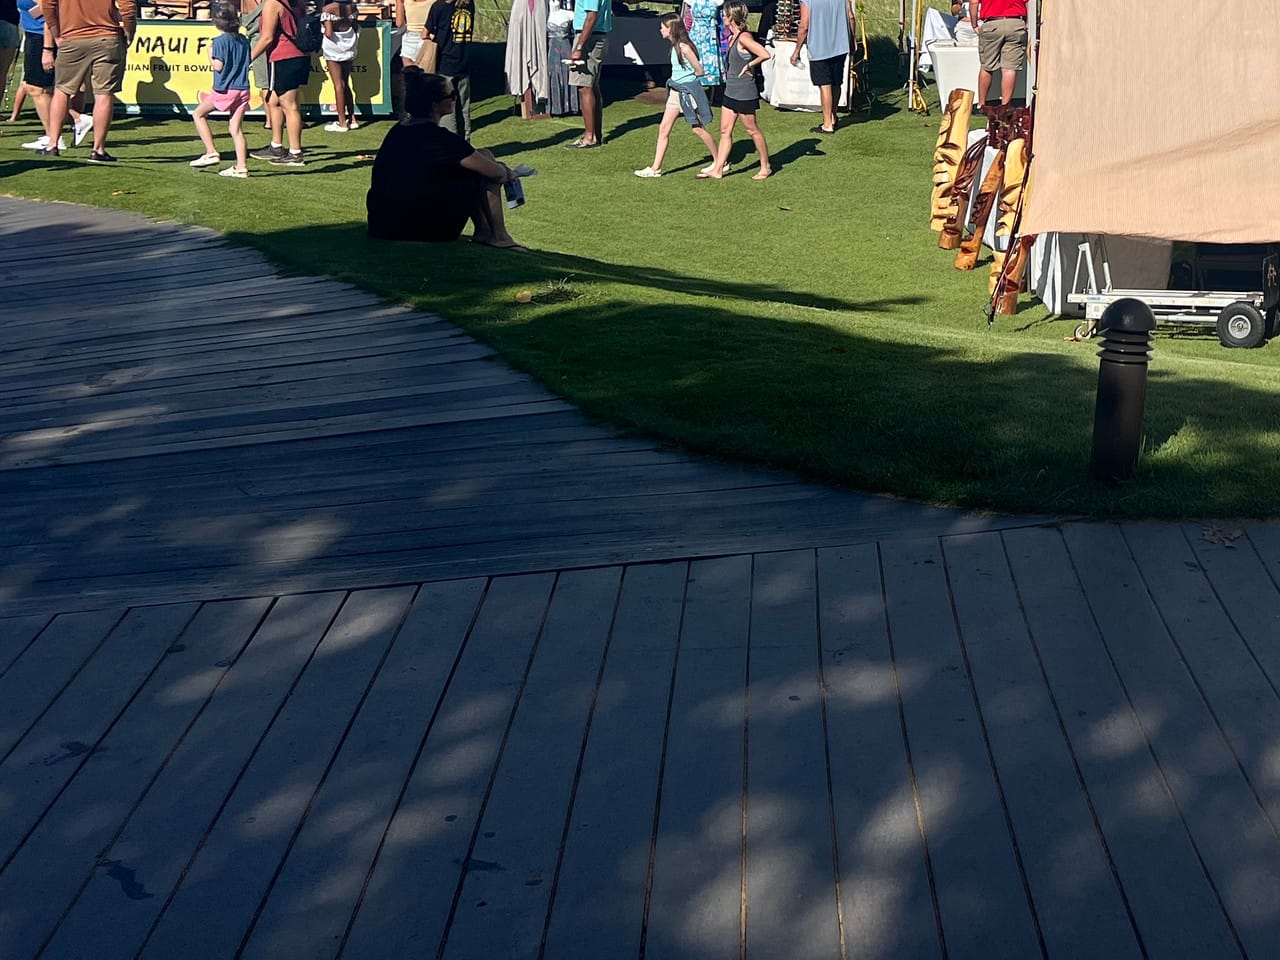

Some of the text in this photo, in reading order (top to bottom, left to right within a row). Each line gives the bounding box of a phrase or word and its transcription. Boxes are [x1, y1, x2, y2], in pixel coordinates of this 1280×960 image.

[135, 36, 188, 55] MAUI
[124, 64, 150, 72] IIAN
[153, 64, 181, 72] FRUIT
[183, 64, 214, 73] BOWL
